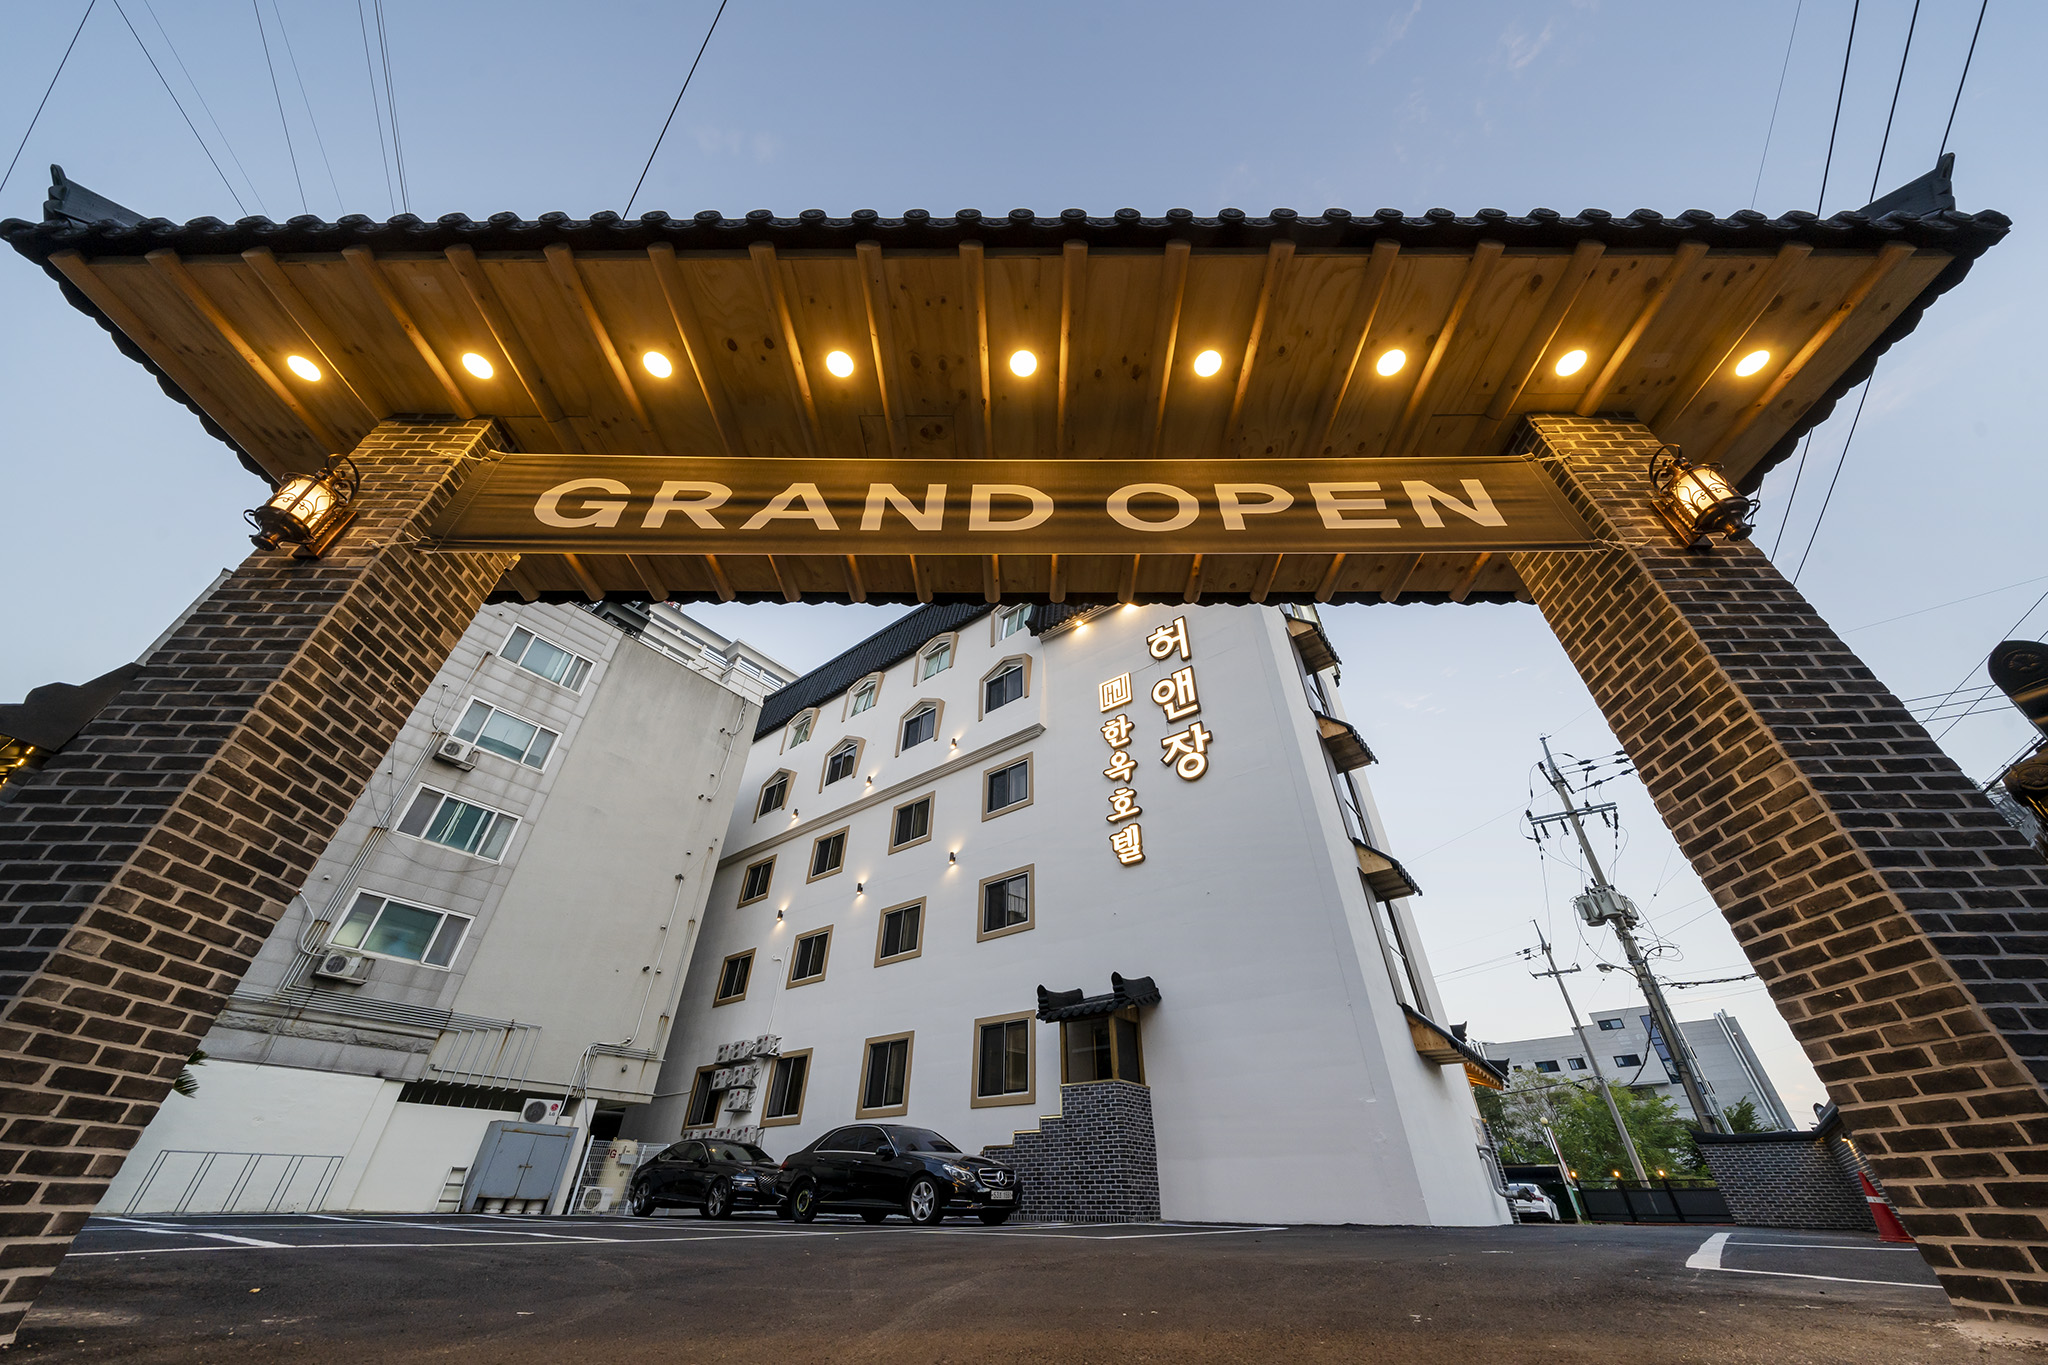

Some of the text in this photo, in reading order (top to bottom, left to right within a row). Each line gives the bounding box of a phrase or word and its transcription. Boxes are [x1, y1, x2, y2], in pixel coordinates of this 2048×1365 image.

[533, 477, 1508, 532] GRAND OPEN
[1146, 615, 1213, 781] 허앤장
[1100, 713, 1145, 867] 한옥호텔
